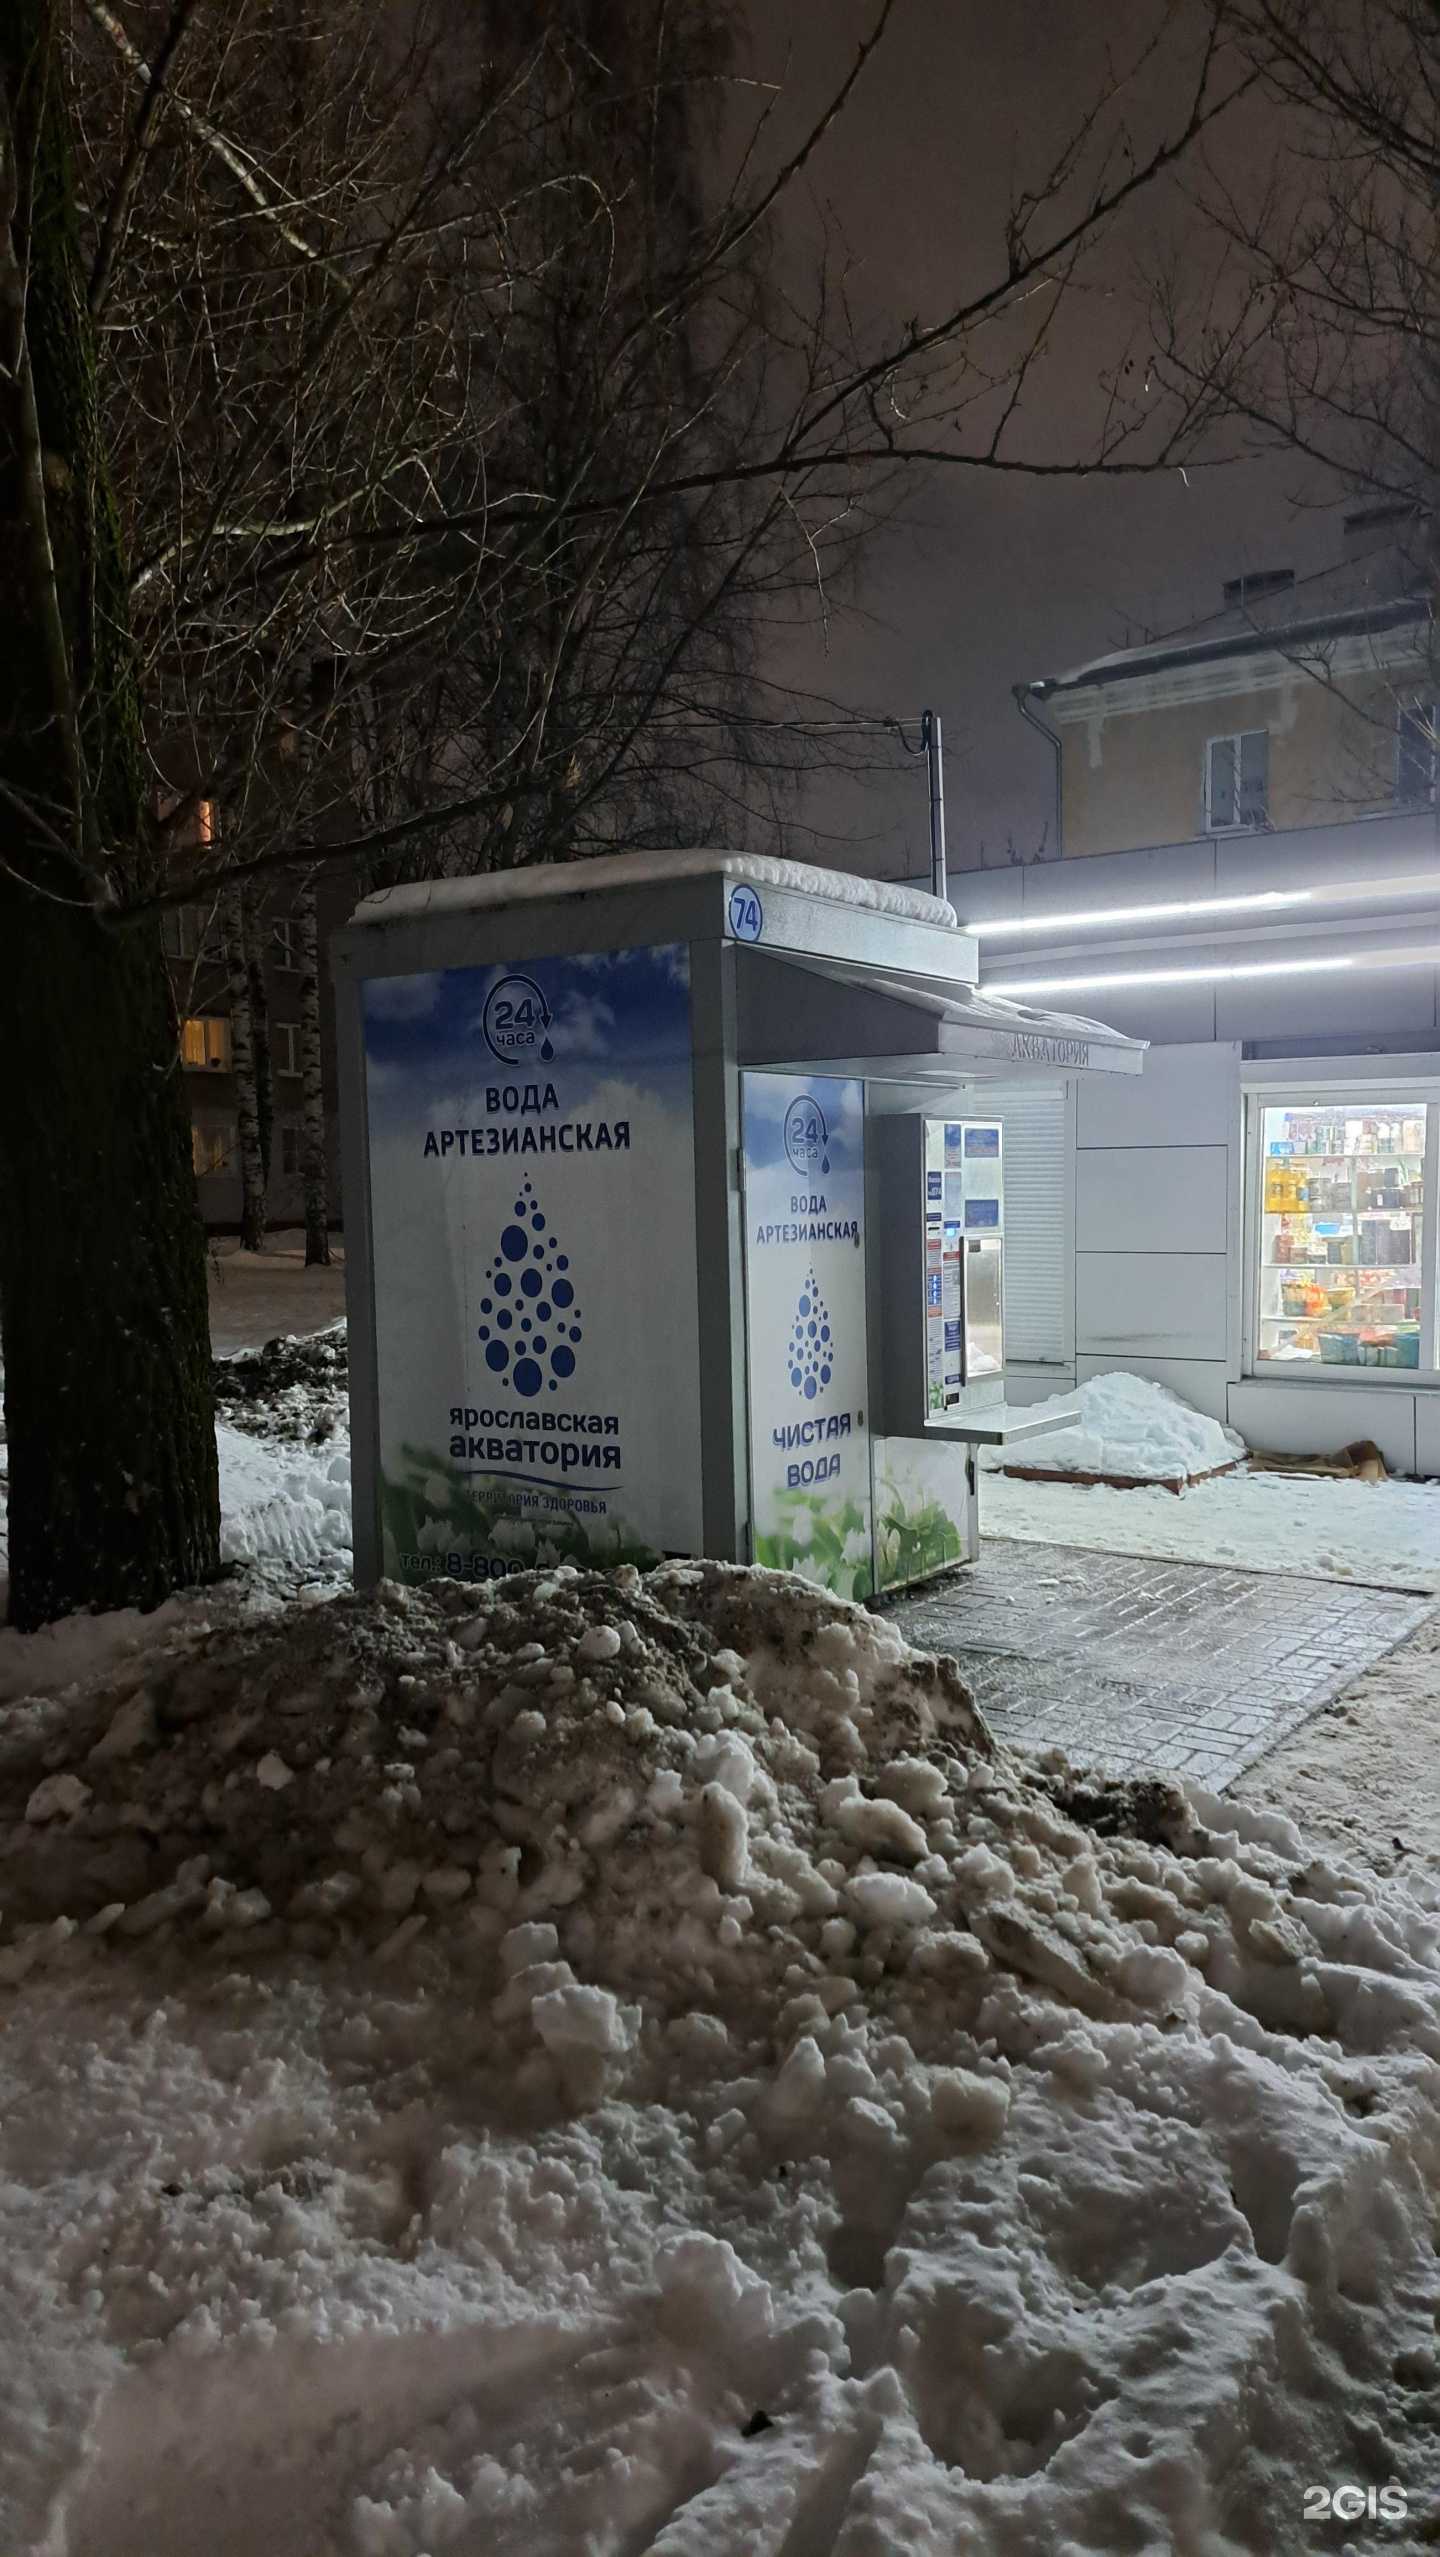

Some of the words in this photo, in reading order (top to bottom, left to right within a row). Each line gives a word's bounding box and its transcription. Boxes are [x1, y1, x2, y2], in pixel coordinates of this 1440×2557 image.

[732, 896, 759, 932] 74
[494, 999, 535, 1031] 24
[495, 1031, 535, 1047] часа
[1011, 1032, 1089, 1067] АКВАТОРИЯ
[485, 1083, 560, 1116] ВОДА
[424, 1121, 630, 1158] АРТЕЗИАНСКАЯ
[791, 1117, 819, 1144] 24
[792, 1147, 818, 1159] часа
[790, 1195, 827, 1215] ВОДА
[756, 1221, 858, 1245] АРТЕЗИАНСКАЯ
[449, 1407, 619, 1436] ярославская
[772, 1412, 852, 1450] ЧИСТАЯ
[449, 1435, 621, 1472] акватория
[786, 1453, 841, 1489] ВОДА
[542, 1496, 607, 1514] ЗДОРОВЬЯ
[401, 1553, 441, 1571] тел.:
